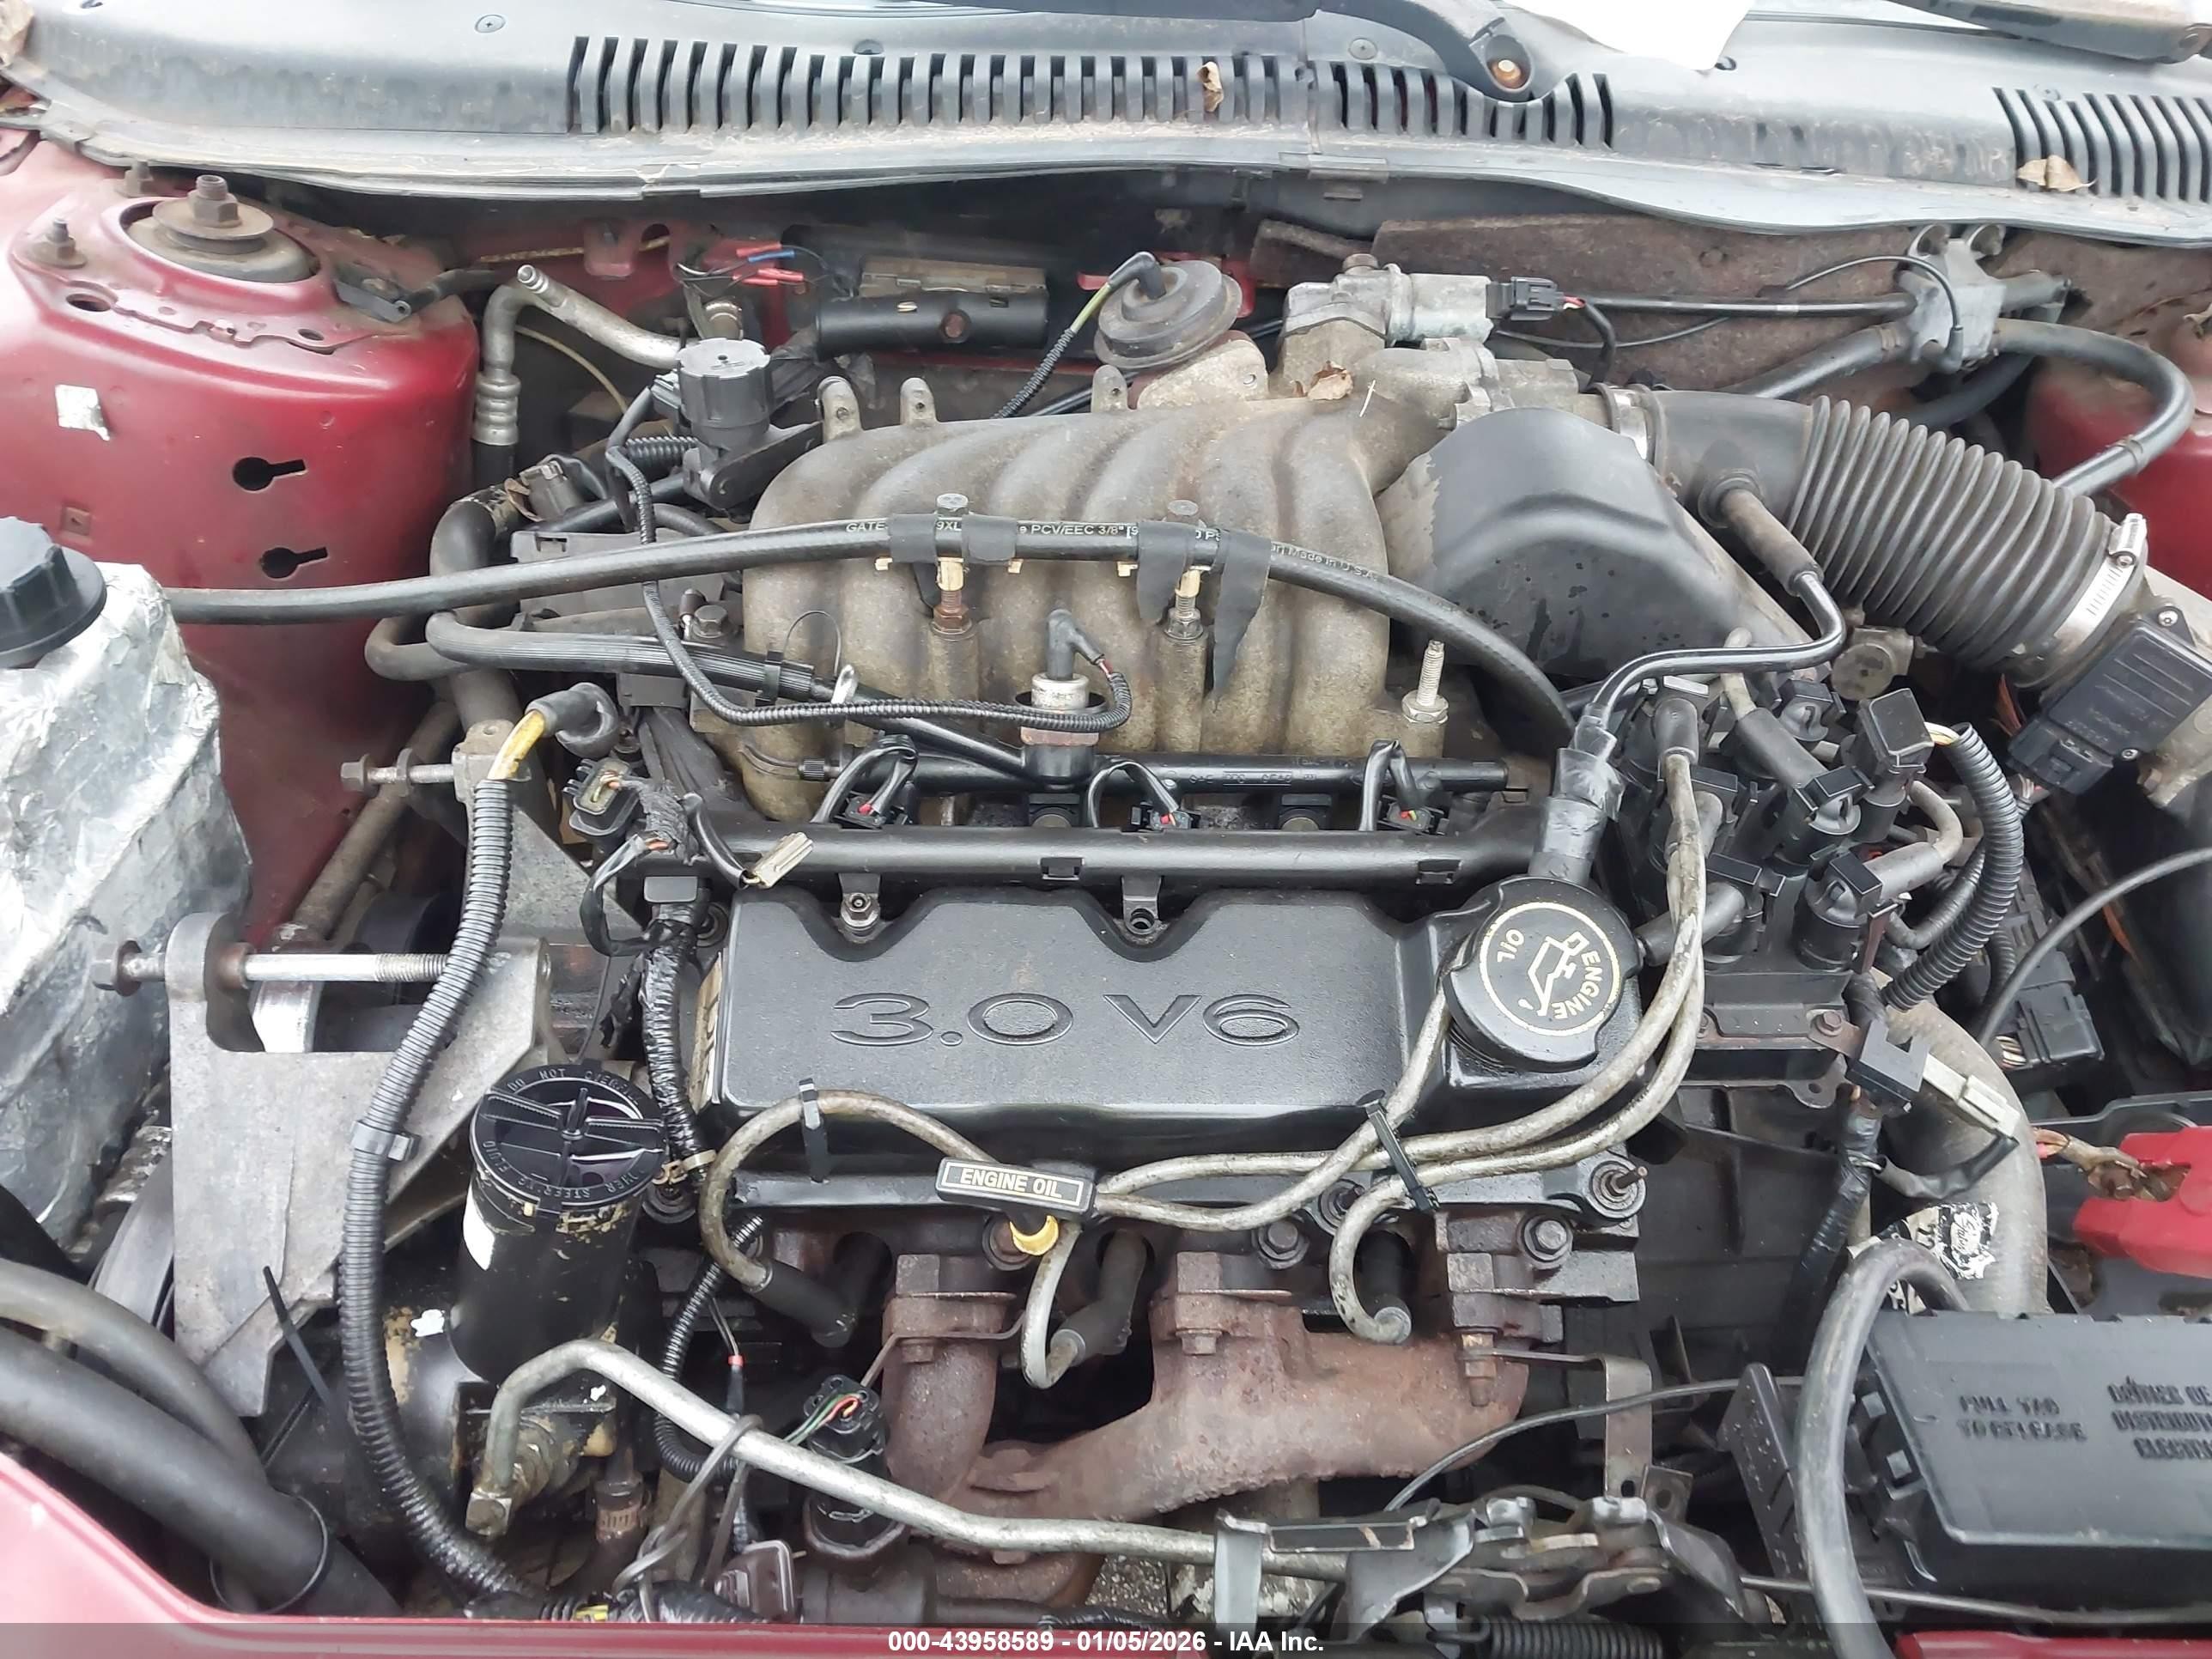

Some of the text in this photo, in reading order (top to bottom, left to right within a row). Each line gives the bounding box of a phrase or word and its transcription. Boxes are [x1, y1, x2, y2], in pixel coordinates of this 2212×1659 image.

[846, 520, 889, 532] GATE
[1030, 522, 1095, 536] PCV/EEC
[1497, 928, 1525, 963] OIL
[1552, 950, 1603, 1019] ENGINE
[830, 992, 1301, 1047] 3.0 V6
[507, 1079, 526, 1091] DO
[539, 1068, 566, 1080] NOT
[960, 1168, 1062, 1199] ENGINE OIL
